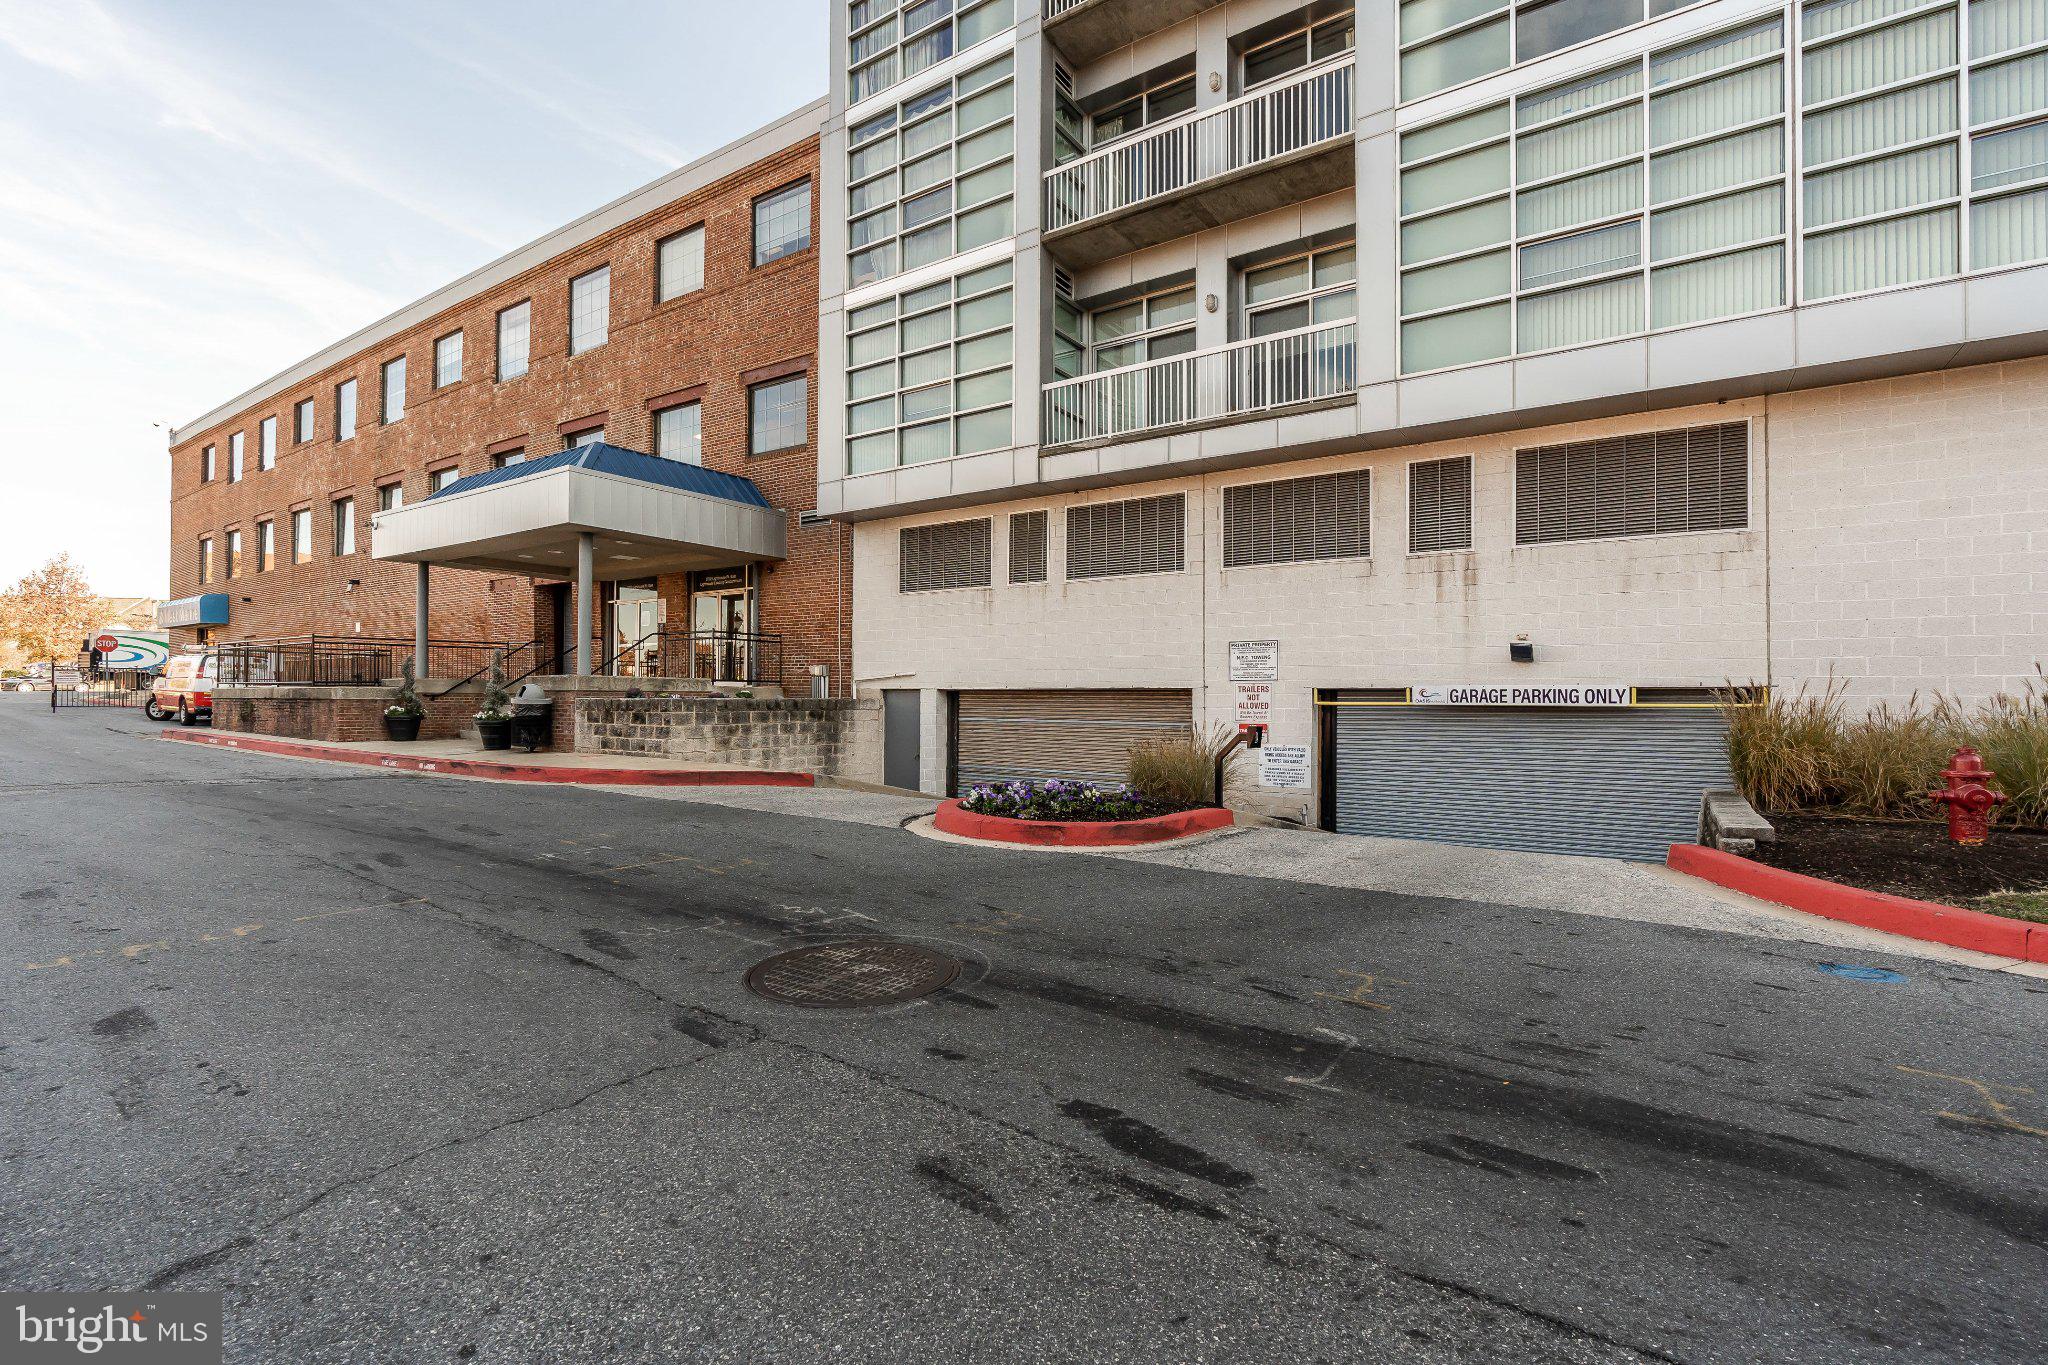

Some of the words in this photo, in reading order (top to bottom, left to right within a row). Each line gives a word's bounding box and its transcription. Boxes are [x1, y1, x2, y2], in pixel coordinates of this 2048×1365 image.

[96, 640, 117, 648] STOP
[1237, 685, 1270, 693] TRAILERS
[1247, 693, 1260, 701] NOT
[1449, 688, 1508, 704] GARAGE
[1512, 688, 1580, 704] PARKING
[1585, 688, 1627, 704] ONLY
[1238, 702, 1269, 710] ALLOWED
